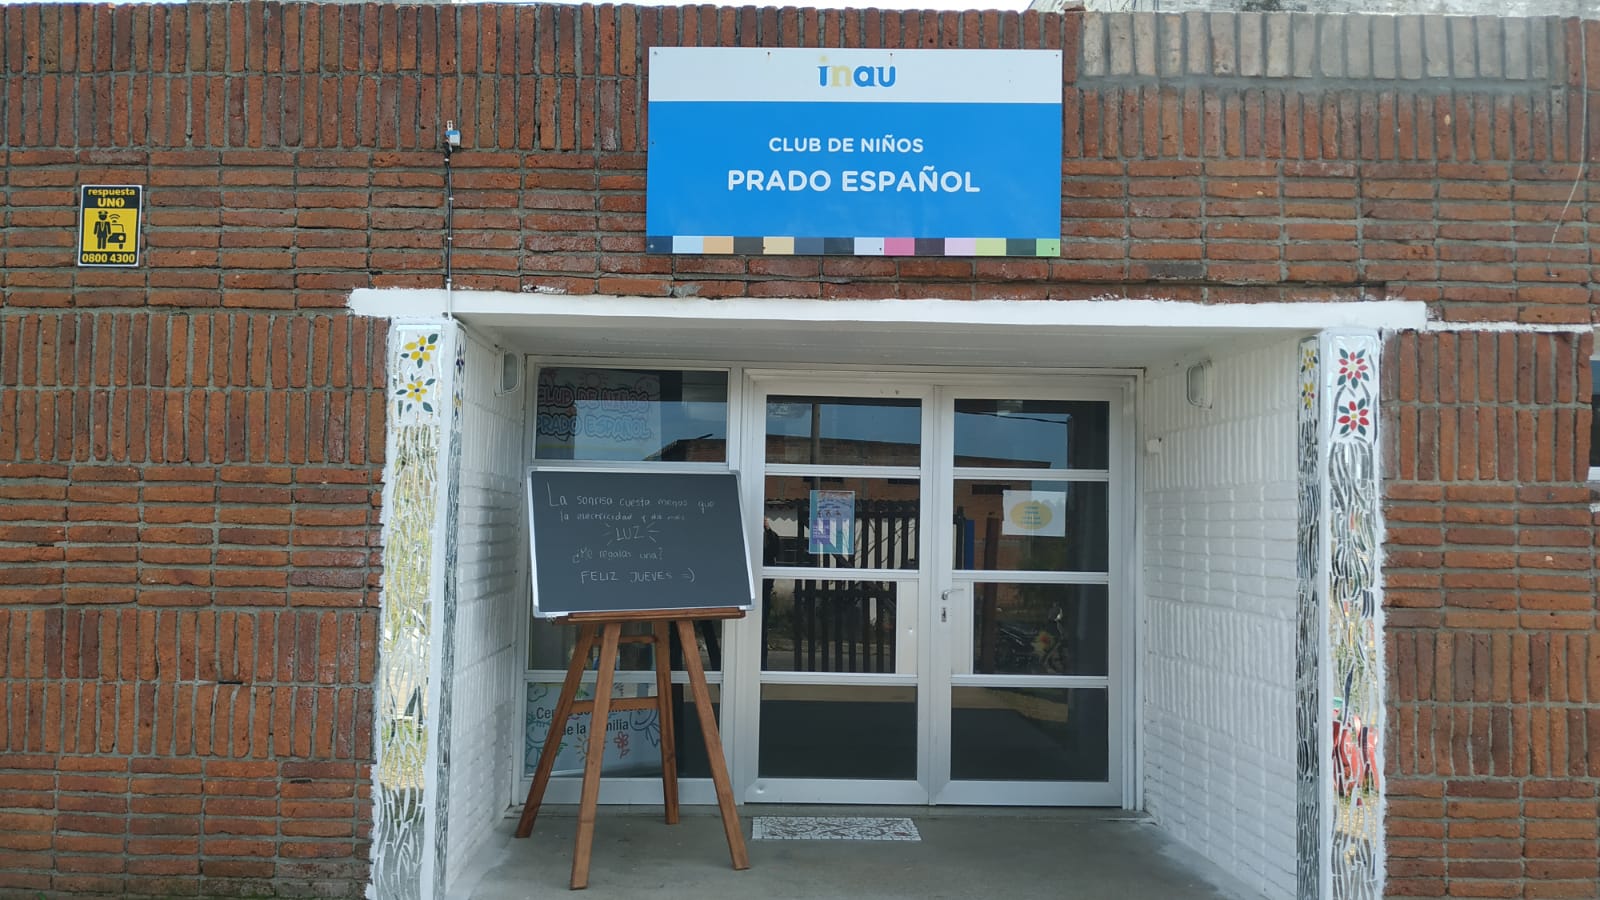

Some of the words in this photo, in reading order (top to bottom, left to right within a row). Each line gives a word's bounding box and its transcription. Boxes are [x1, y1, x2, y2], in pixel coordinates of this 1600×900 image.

[817, 55, 897, 88] inau
[768, 137, 822, 152] CLUB
[828, 138, 854, 152] DE
[861, 134, 924, 153] NIÑOS
[727, 169, 832, 192] PRADO
[841, 165, 981, 193] ESPAÑOL
[87, 188, 136, 197] respuesta
[97, 198, 125, 208] UNO
[82, 253, 108, 263] 0800
[110, 253, 136, 263] 4300
[585, 416, 652, 439] ESPAÑOL
[547, 481, 568, 507] La
[560, 511, 569, 522] la
[615, 525, 645, 541] LUZ
[580, 571, 620, 584] FELIZ
[629, 570, 674, 584] JUEVES
[576, 723, 587, 735] la
